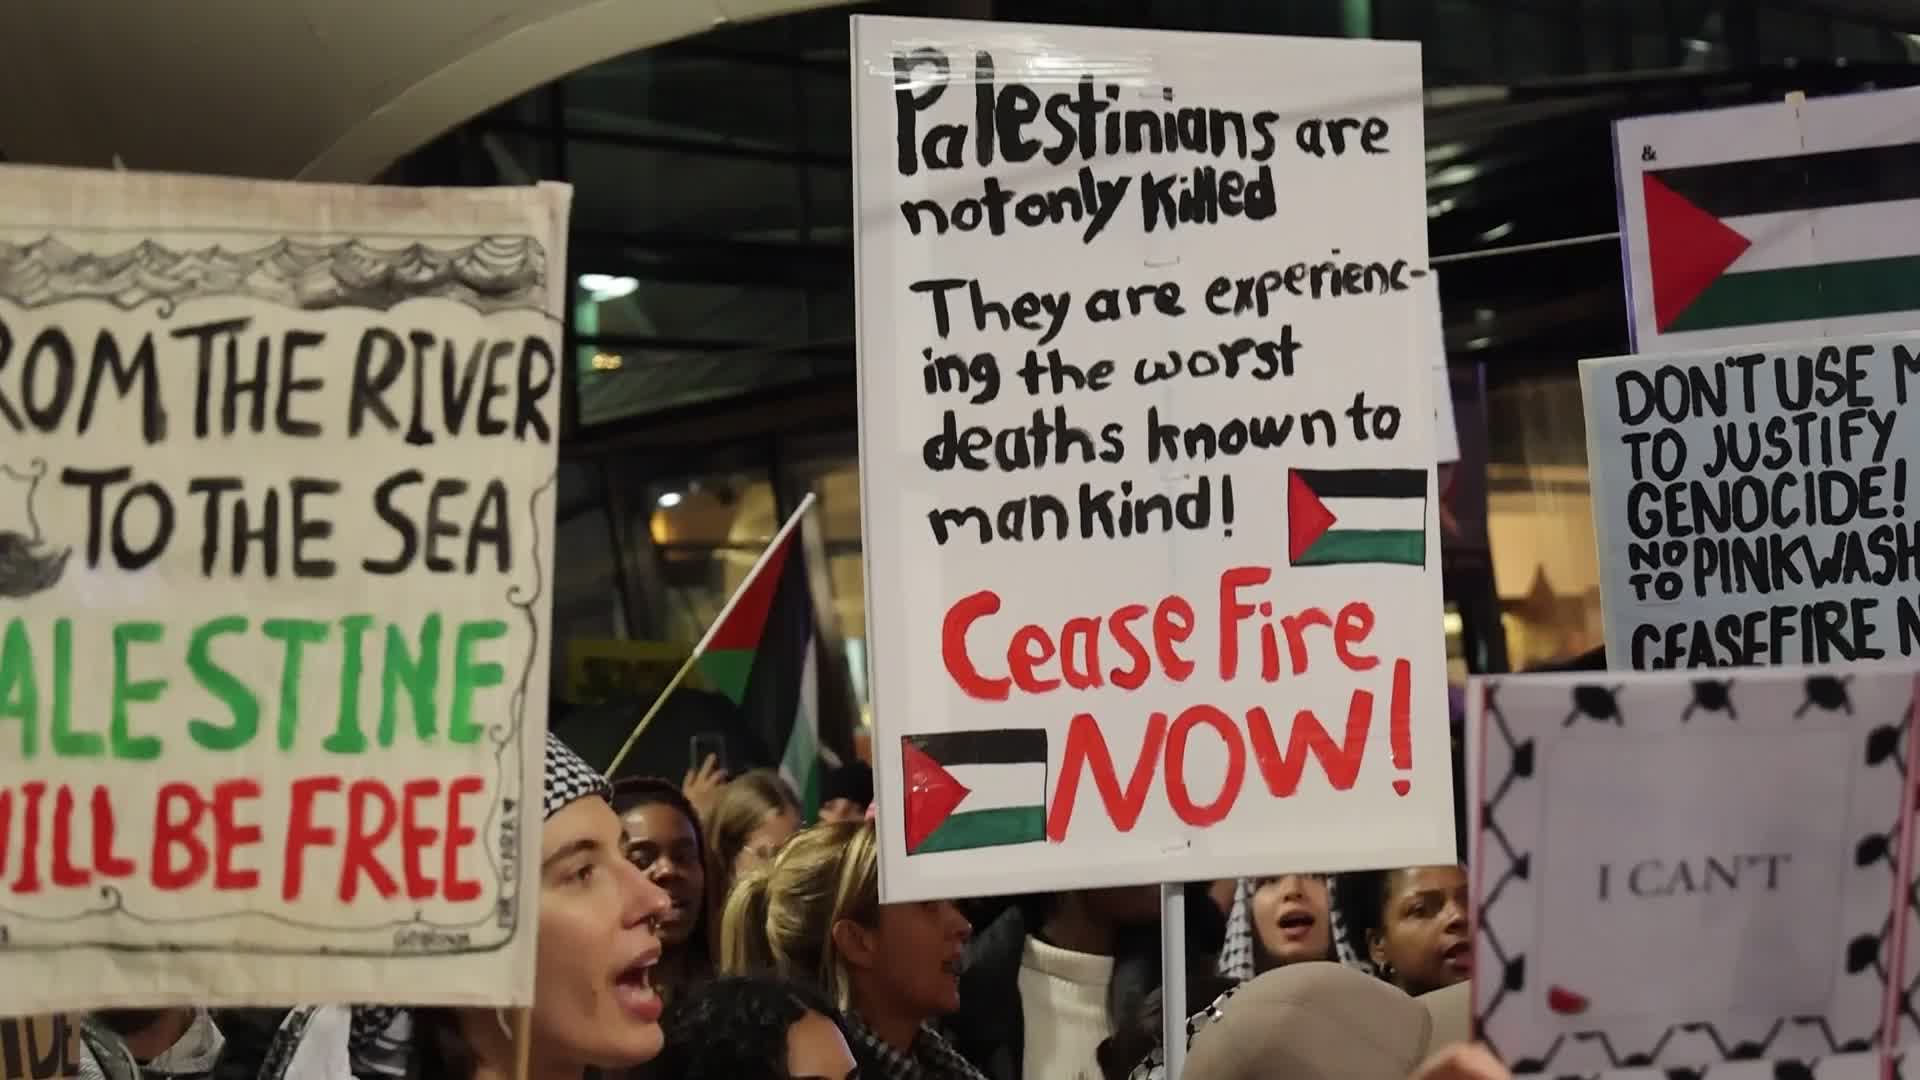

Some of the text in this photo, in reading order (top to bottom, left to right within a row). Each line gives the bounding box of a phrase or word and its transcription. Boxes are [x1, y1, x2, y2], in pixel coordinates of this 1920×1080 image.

[892, 46, 1391, 177] Palestinians are
[909, 248, 1427, 345] They are experienc-
[170, 316, 325, 439] THE
[348, 327, 555, 445] RIVER
[922, 325, 1302, 404] ing the worst
[1616, 353, 1765, 426] DON'T
[1774, 345, 1874, 411] USE
[923, 392, 1399, 471] deaths known to
[1621, 408, 1896, 482] TO JUSTIFY
[61, 466, 510, 578] TO THE SEA
[1627, 458, 1906, 539] GENOCIDE!
[1628, 540, 1687, 570] NO
[1629, 571, 1683, 601] TO
[941, 566, 1380, 702] Cease Fire
[1631, 597, 1885, 672] CEASEFIRE
[1046, 658, 1413, 844] NOW!
[150, 778, 262, 891] BE
[282, 776, 484, 904] FREE
[1598, 853, 1792, 902] I CAN'T
